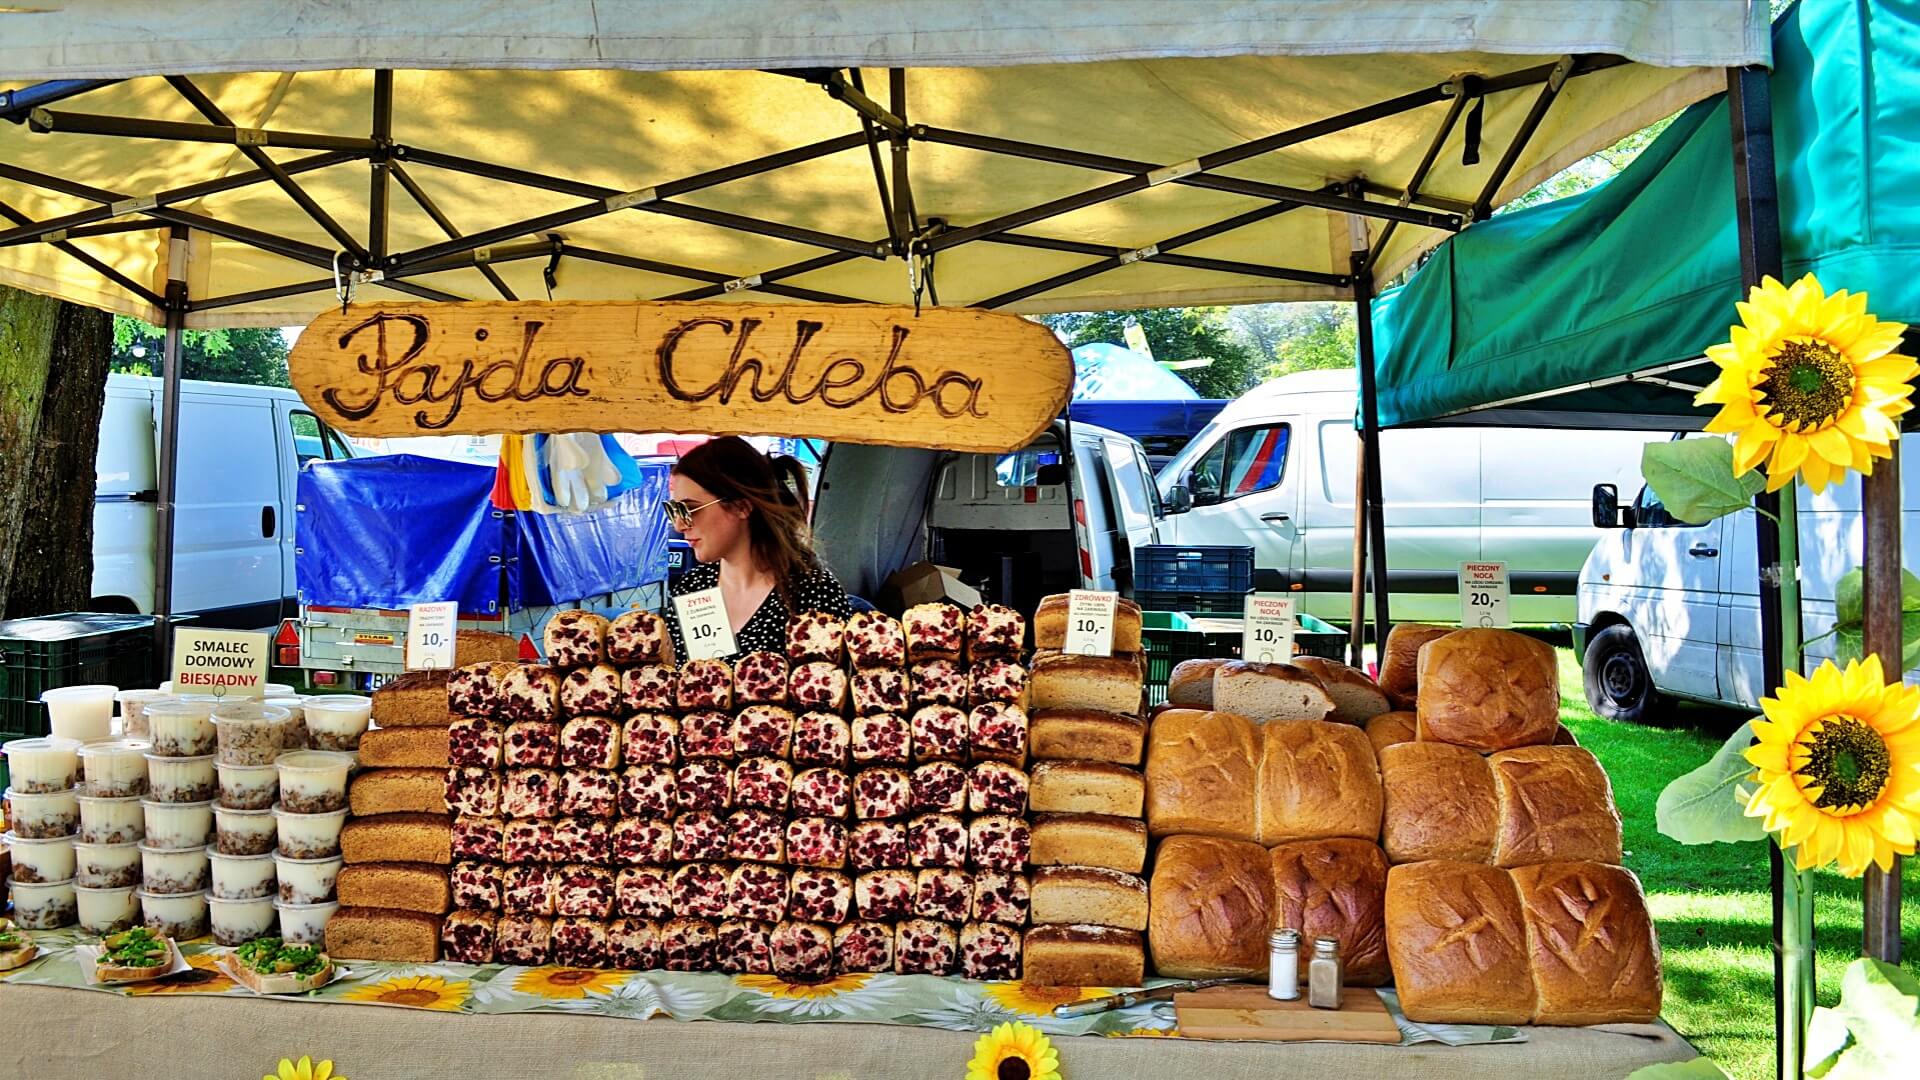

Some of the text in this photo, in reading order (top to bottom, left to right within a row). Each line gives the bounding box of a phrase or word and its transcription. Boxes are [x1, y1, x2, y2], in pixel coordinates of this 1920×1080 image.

[322, 311, 989, 429] Pajda Chleba
[687, 596, 712, 608] ŻYTNI
[1254, 600, 1288, 608] PIECZONY
[1471, 592, 1500, 608] 20,-
[692, 624, 722, 640] 10,-
[1076, 619, 1105, 634] 10,-
[422, 632, 448, 648] 10,-
[1254, 628, 1284, 644] 10,-
[193, 640, 249, 654] SMALEC
[185, 655, 255, 668] DOMOWY
[180, 672, 258, 687] BIESIADNY
